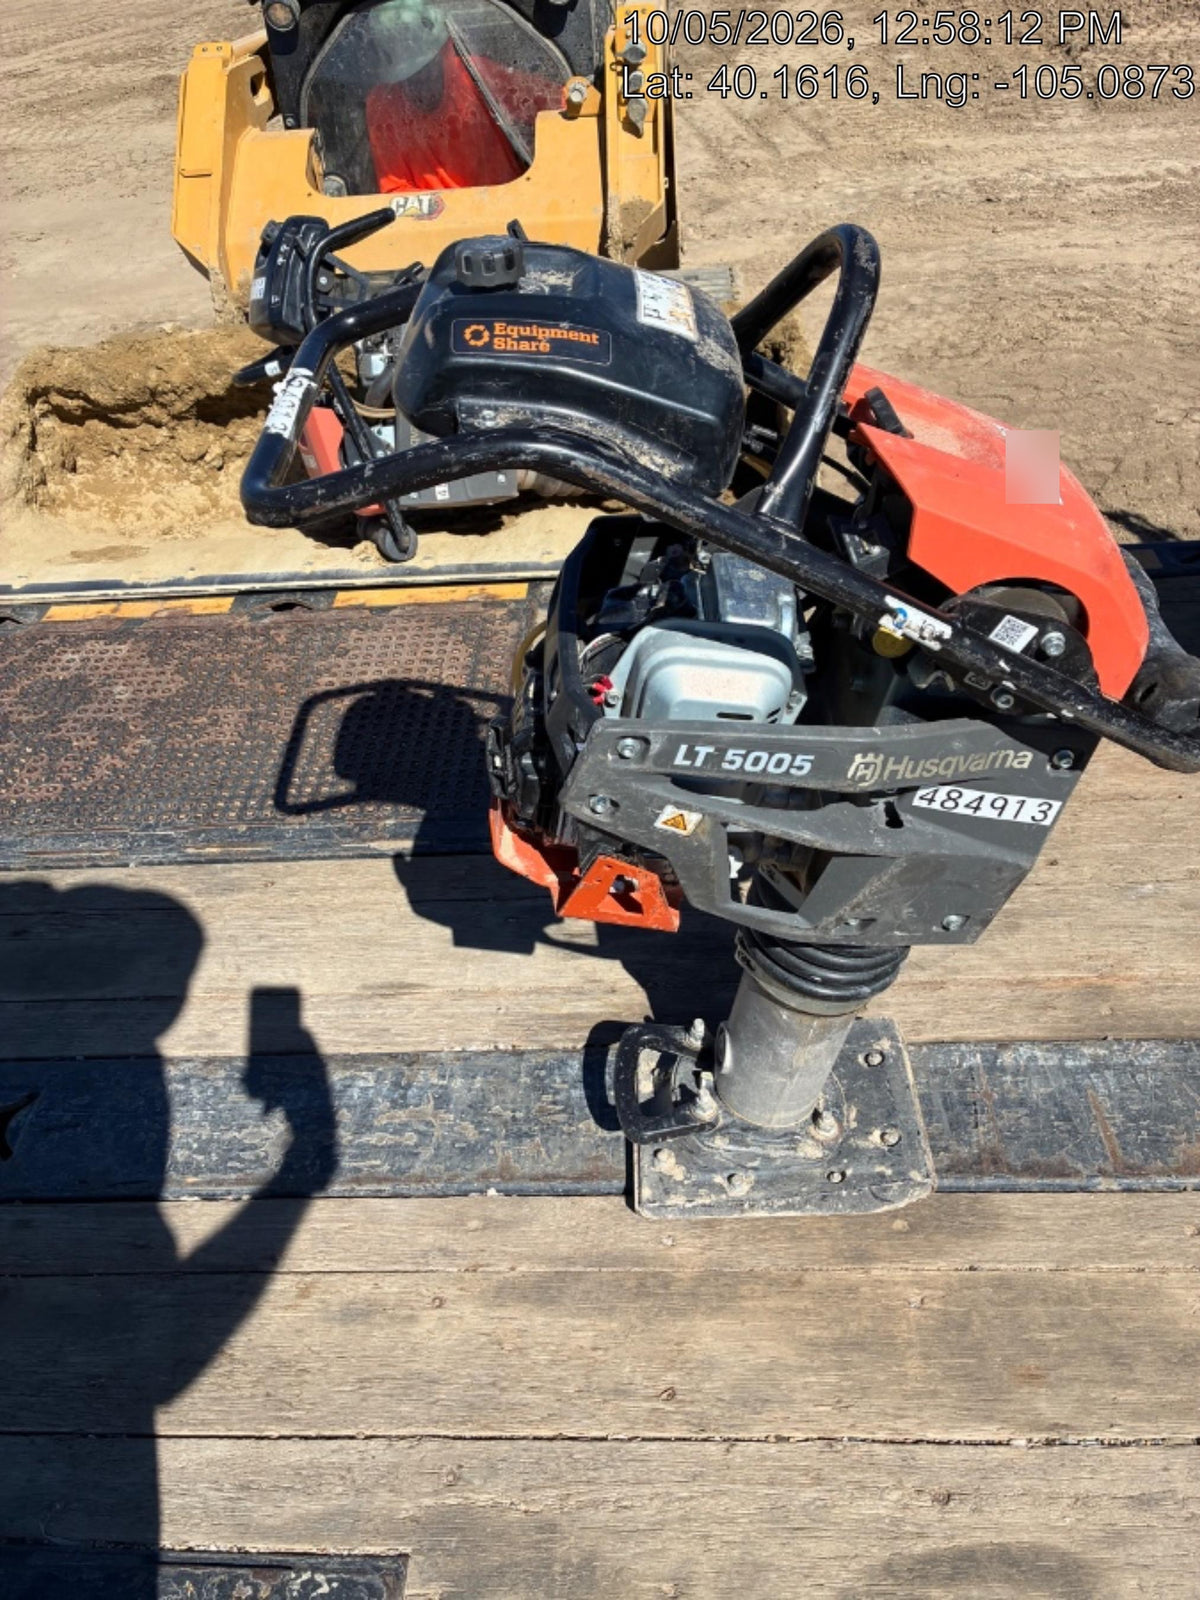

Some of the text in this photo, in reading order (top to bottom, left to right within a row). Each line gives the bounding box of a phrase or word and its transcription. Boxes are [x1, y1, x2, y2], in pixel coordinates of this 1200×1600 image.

[390, 194, 432, 216] CAT
[493, 322, 600, 345] Equipment
[493, 337, 551, 353] Share
[674, 744, 815, 776] LT 5005
[883, 750, 1033, 781] Husqvarna
[917, 787, 1054, 824] 484913
